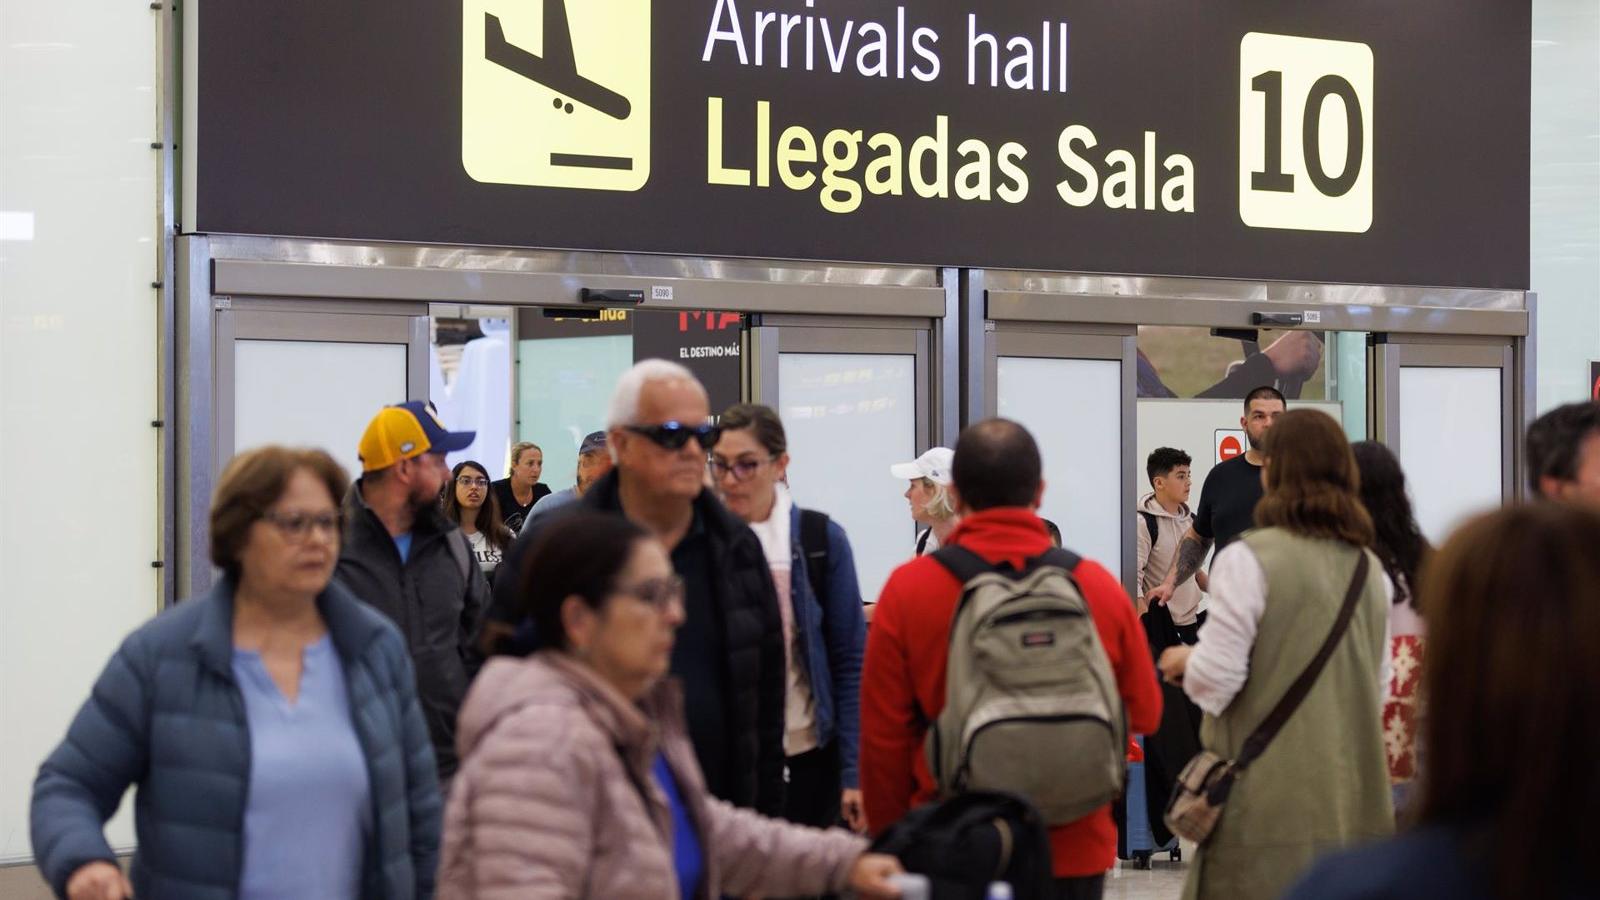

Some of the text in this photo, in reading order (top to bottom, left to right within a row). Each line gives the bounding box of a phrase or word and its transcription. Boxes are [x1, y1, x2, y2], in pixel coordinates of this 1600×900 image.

[701, 0, 1067, 92] Arrivals hall
[707, 97, 1195, 213] Llegadas Sala
[1251, 70, 1363, 197] 10
[655, 288, 669, 297] 5090
[680, 347, 689, 358] EL
[690, 345, 723, 358] DESTINO
